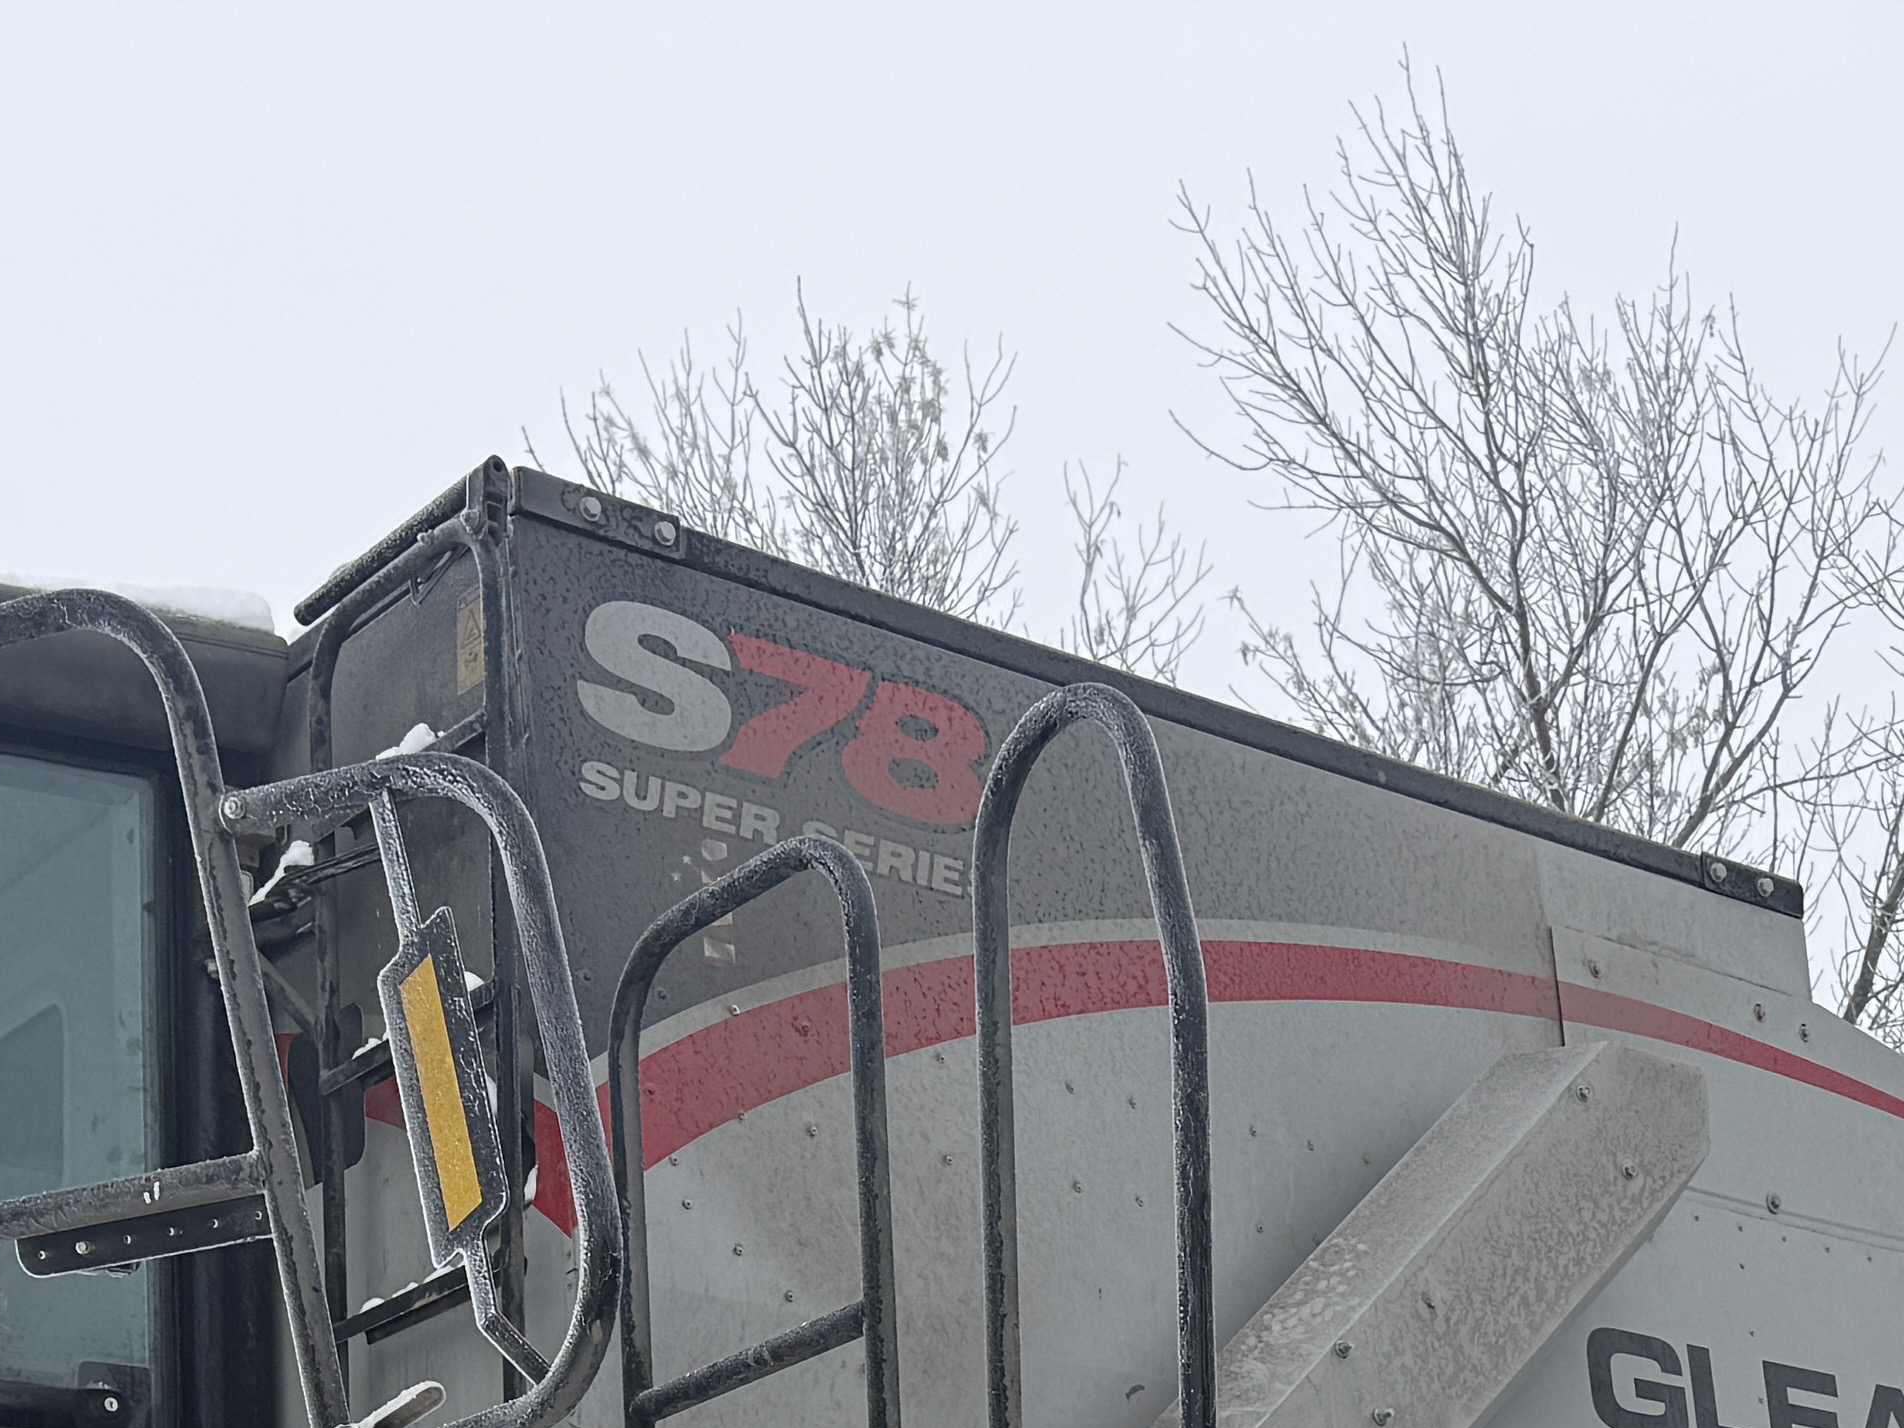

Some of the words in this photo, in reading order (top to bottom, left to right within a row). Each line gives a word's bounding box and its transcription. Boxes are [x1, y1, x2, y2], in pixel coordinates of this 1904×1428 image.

[577, 600, 988, 825] S78
[578, 760, 781, 844] SUPER
[802, 821, 974, 896] ERIE
